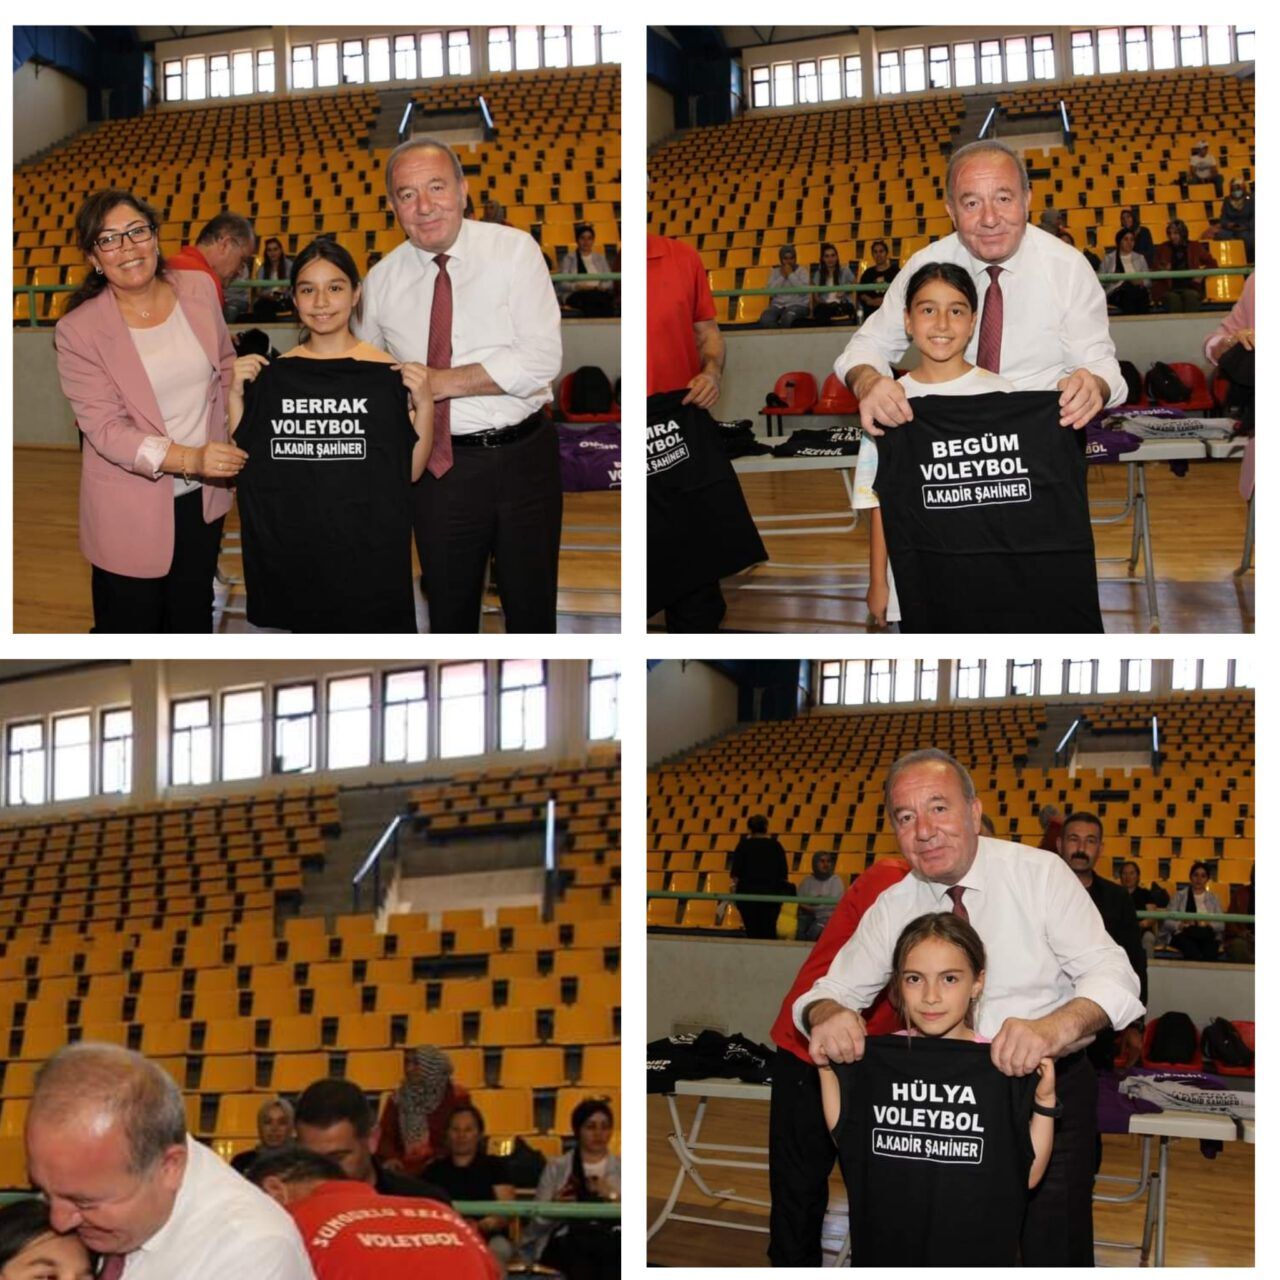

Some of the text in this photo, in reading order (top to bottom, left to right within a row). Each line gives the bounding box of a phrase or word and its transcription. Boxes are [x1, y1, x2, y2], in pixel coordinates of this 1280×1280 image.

[282, 398, 368, 413] BERRAK
[271, 419, 365, 434] VOLEYBOL
[275, 441, 362, 458] A.KADİR ŞAHİNER
[932, 433, 1019, 458] BEGÜM
[920, 457, 1029, 480] VOLEYBOL
[927, 482, 1027, 503] A.KADİR ŞAHİNER
[892, 1079, 977, 1105] HÜLYA
[873, 1105, 985, 1133] VOLEYBOL
[876, 1134, 978, 1158] A.KADİR ŞAHİNER
[356, 1232, 464, 1248] VOLEYBOL
